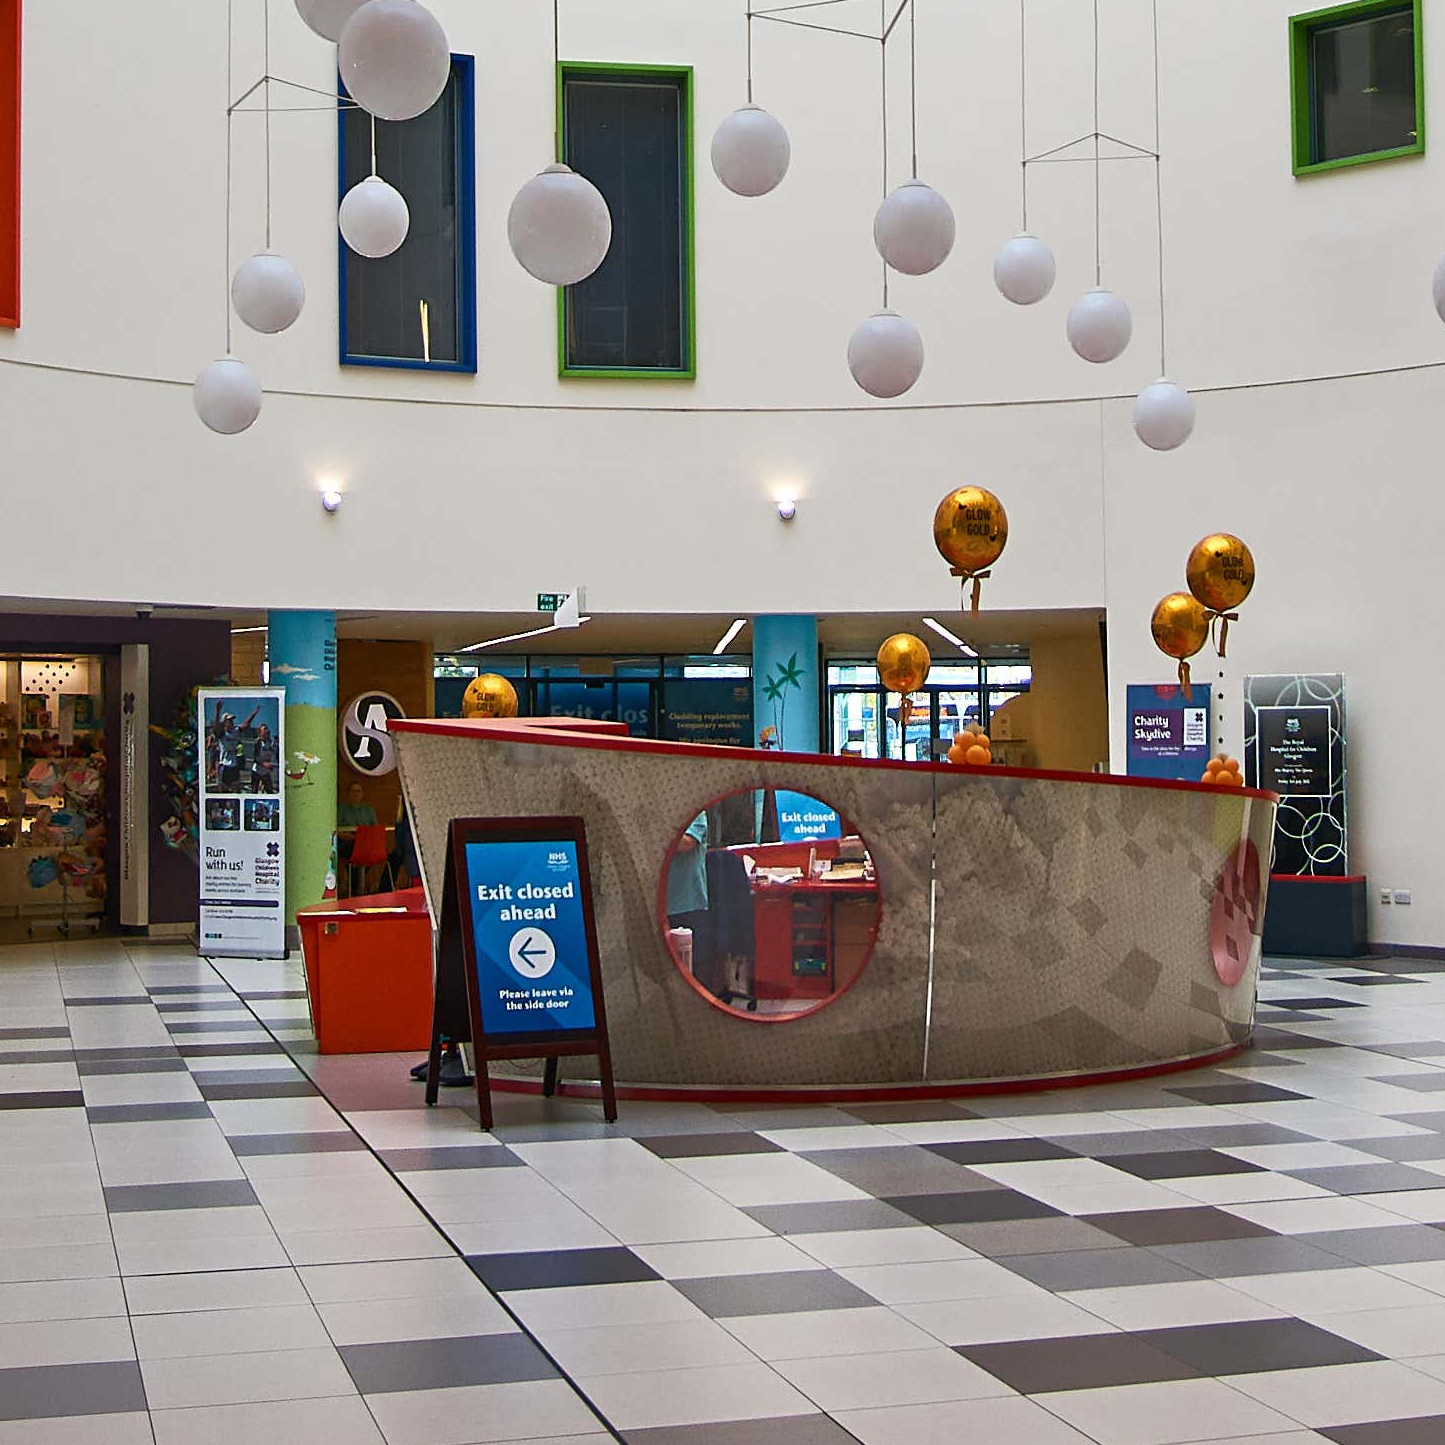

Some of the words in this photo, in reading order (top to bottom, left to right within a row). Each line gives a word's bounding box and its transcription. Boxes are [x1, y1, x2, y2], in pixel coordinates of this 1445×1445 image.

[965, 508, 991, 520] GLOW
[967, 523, 990, 535] GOLD
[1134, 714, 1169, 728] Charity
[1134, 728, 1172, 742] Skydive
[781, 811, 802, 823] Exit
[803, 811, 836, 823] closed
[794, 823, 827, 834] ahead
[205, 846, 226, 858] Run
[548, 851, 567, 860] NHS
[205, 859, 227, 870] with
[229, 859, 244, 871] us!
[255, 877, 280, 886] Charity
[478, 883, 513, 901] Exit
[517, 881, 574, 900] closed
[500, 903, 557, 922] ahead
[499, 989, 530, 999] Please
[532, 988, 558, 998] leave
[559, 986, 574, 997] via
[506, 1001, 523, 1011] the
[525, 1000, 545, 1010] side
[546, 999, 570, 1009] door
